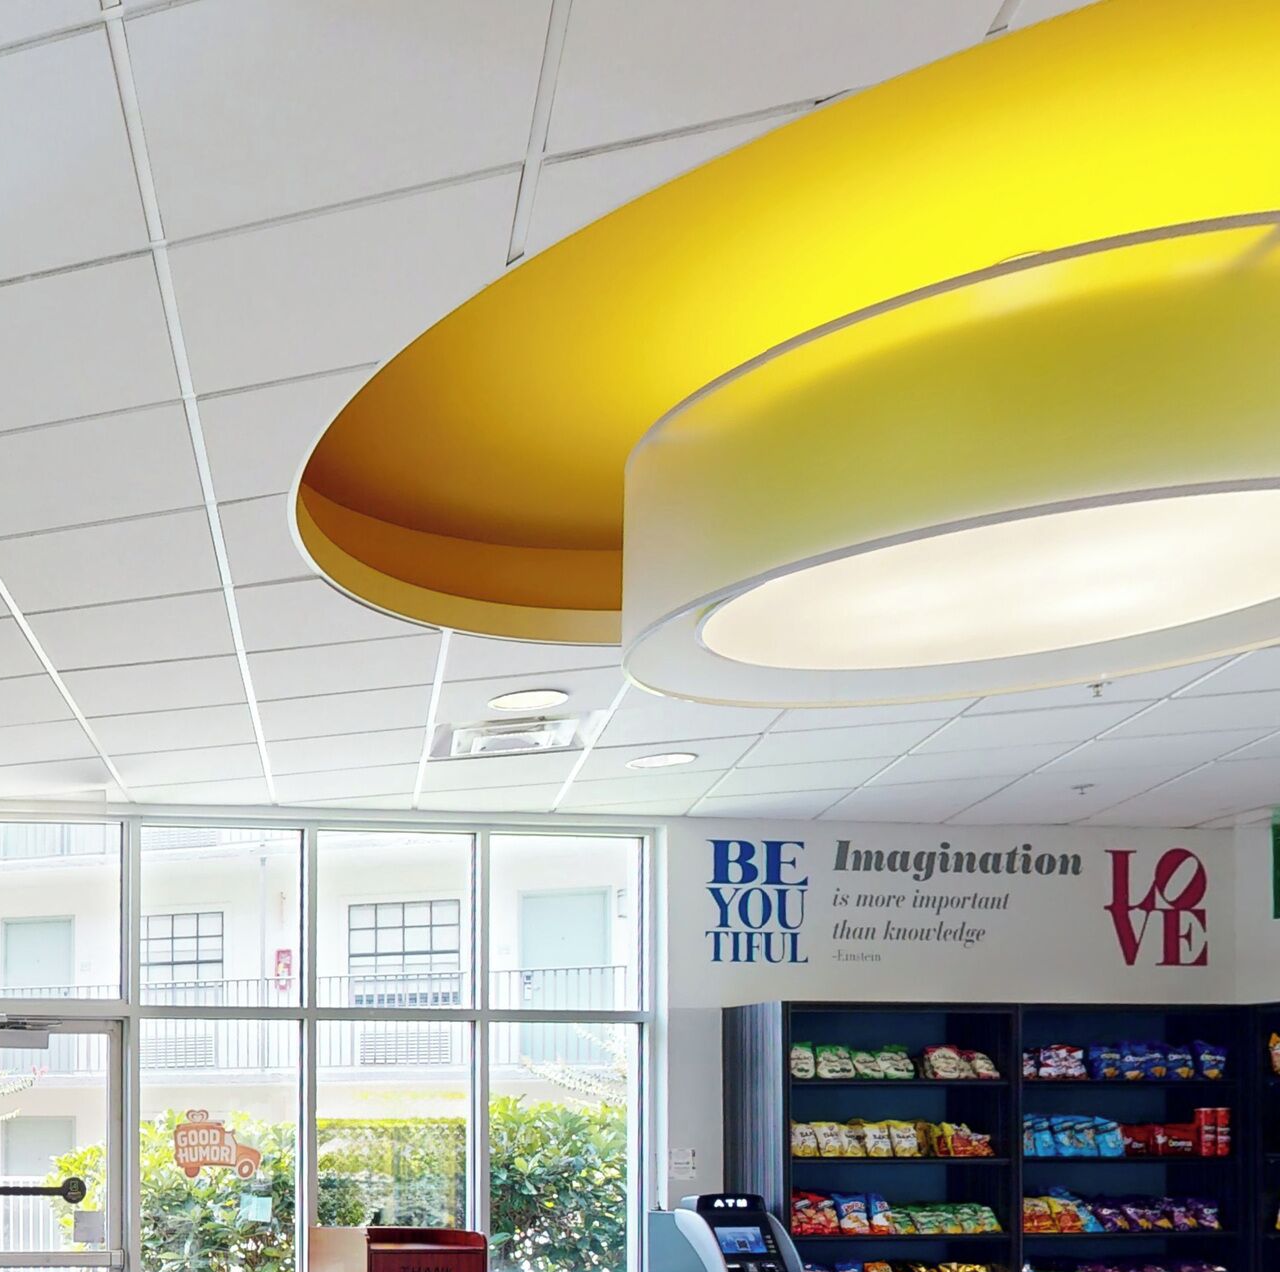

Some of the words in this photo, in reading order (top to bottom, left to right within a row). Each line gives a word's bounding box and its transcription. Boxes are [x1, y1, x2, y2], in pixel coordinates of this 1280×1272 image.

[706, 840, 808, 885] BE
[833, 840, 1083, 881] Imagination
[706, 888, 805, 929] YOU
[832, 890, 849, 908] is
[855, 892, 905, 909] more
[911, 889, 1009, 912] important
[705, 931, 808, 963] TIFUL
[832, 921, 876, 942] than
[883, 921, 986, 949] knowledge
[177, 1129, 220, 1147] GOOD
[178, 1146, 230, 1163] HUMOR
[714, 1199, 748, 1208] ATM
